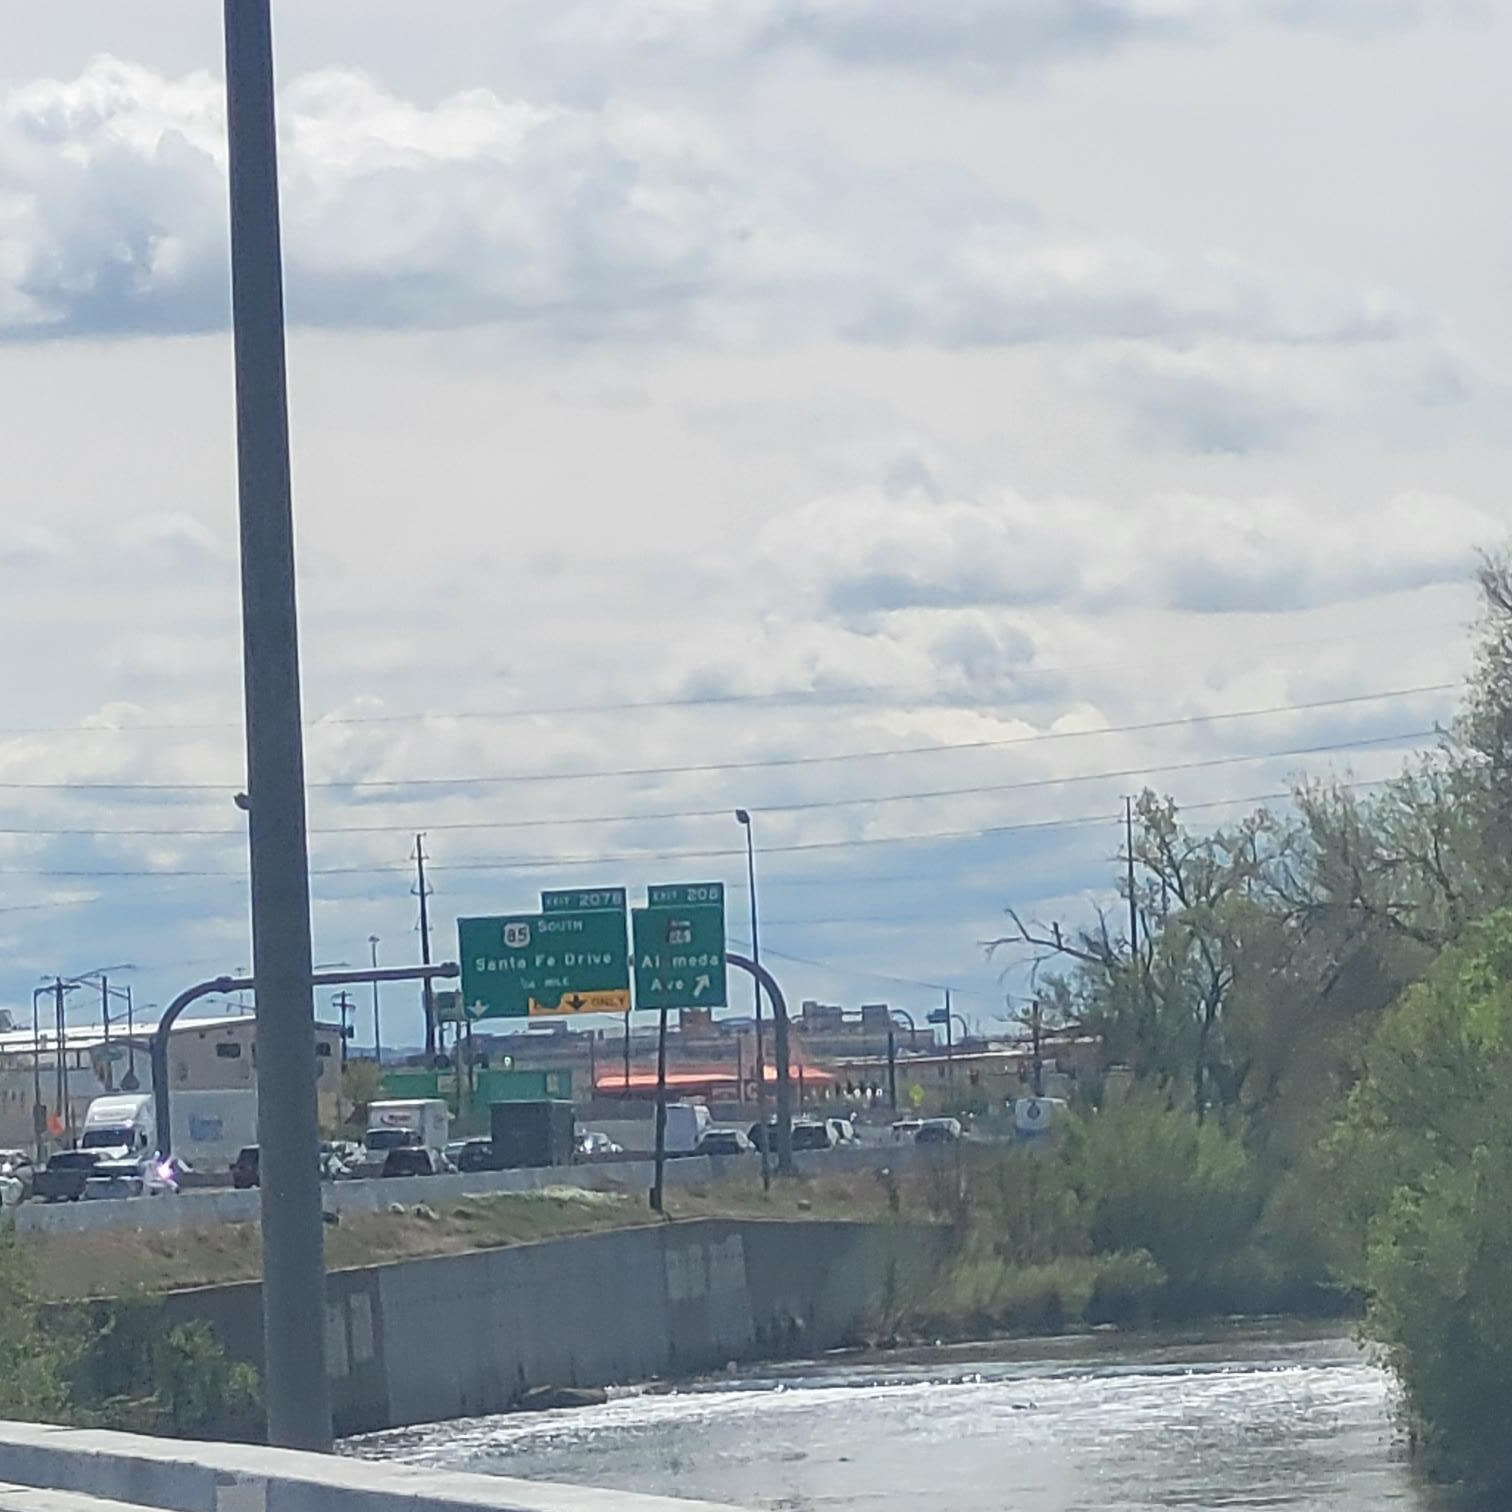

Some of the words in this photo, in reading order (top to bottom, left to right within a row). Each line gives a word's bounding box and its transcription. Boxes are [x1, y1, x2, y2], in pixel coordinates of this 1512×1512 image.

[538, 919, 583, 933] SOUTH
[506, 926, 527, 943] 85
[475, 956, 527, 972] Santa
[535, 953, 556, 968] Fe
[565, 951, 612, 966] Drive
[641, 953, 719, 969] Almeda
[591, 996, 625, 1007] ONLY
